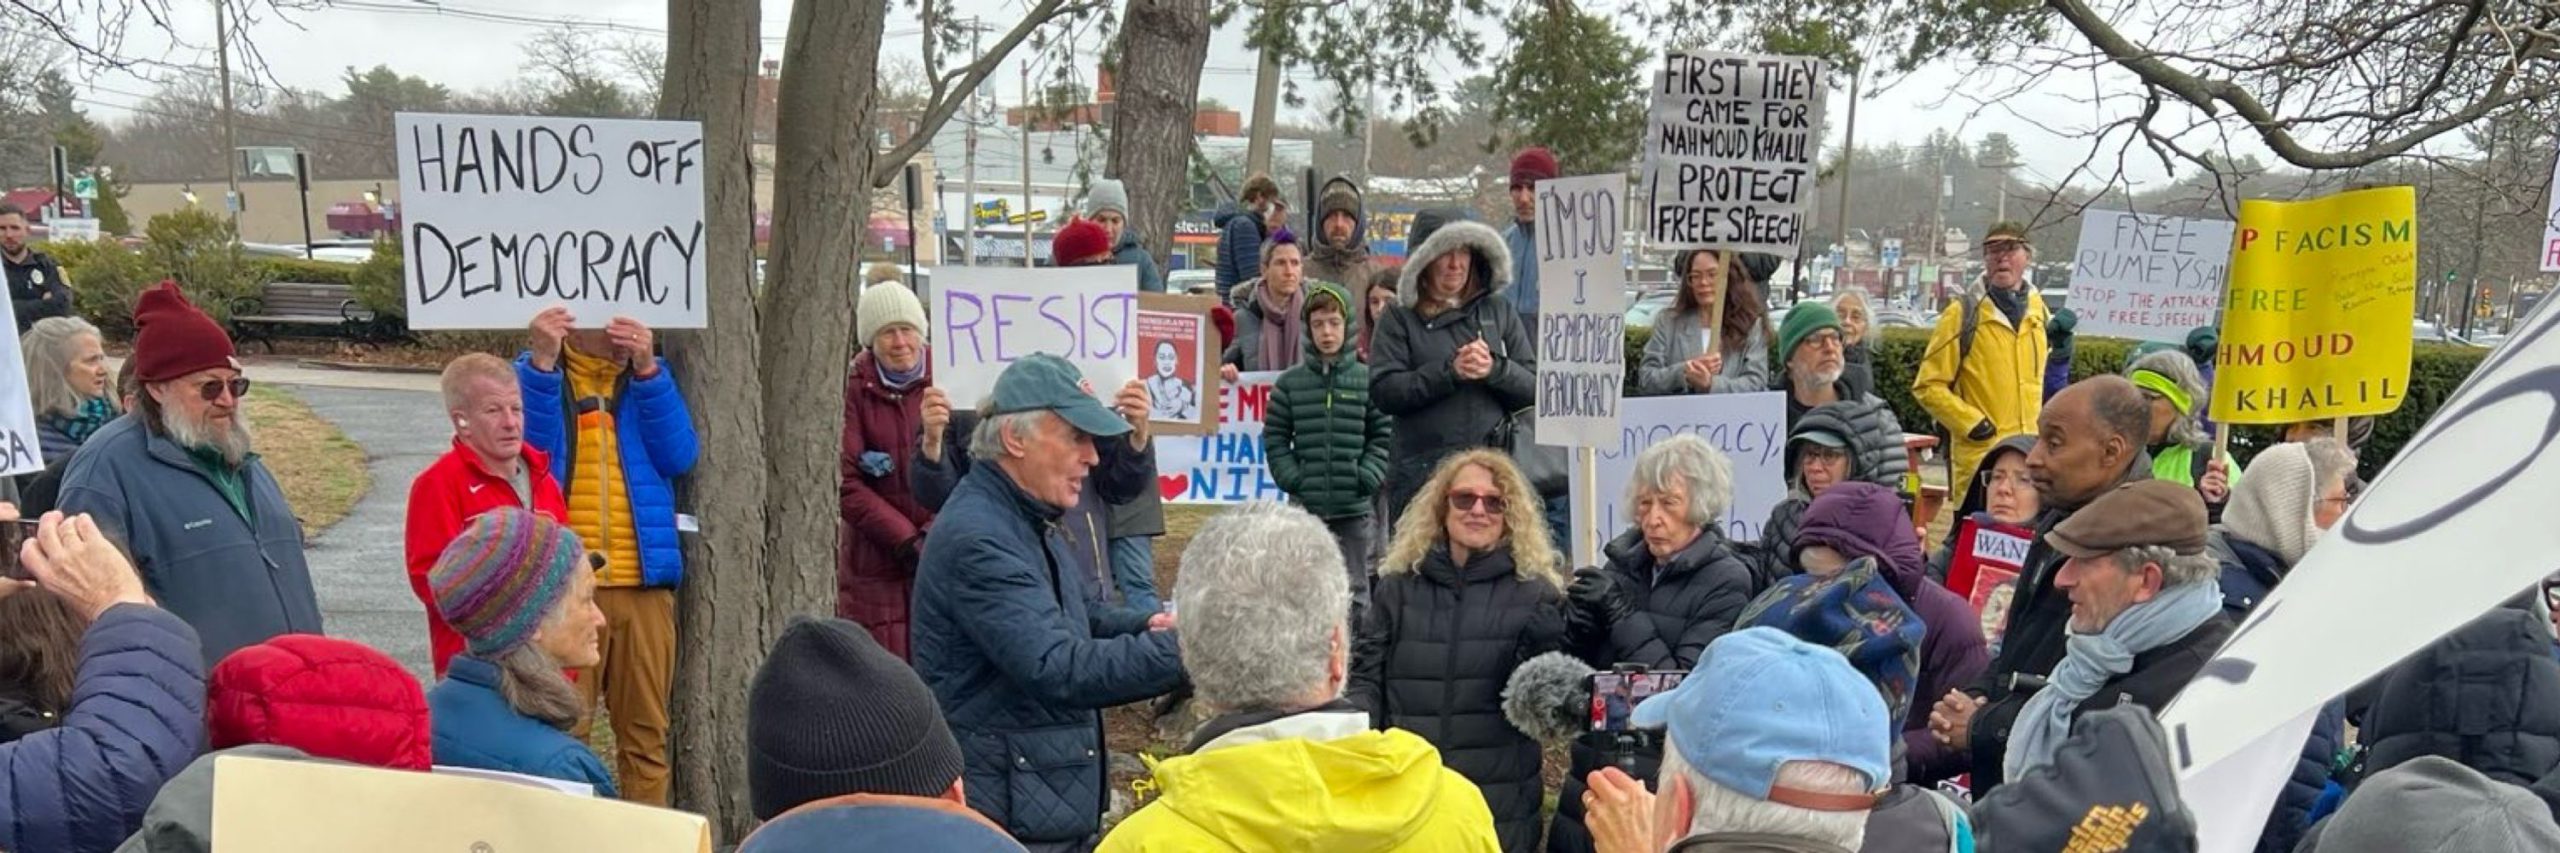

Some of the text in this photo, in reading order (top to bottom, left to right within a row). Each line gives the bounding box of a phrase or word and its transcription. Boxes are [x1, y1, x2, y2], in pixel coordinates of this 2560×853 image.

[1665, 54, 1818, 100] FIRST THEY
[1686, 99, 1809, 128] CAME FOR
[413, 123, 702, 195] HANDS OFF
[1752, 126, 1808, 163] KHALIL
[1679, 163, 1806, 203] PROTECT
[1581, 188, 1616, 256] 90
[1659, 205, 1801, 245] FREE SPEECH
[2115, 214, 2197, 255] FREE
[2275, 220, 2410, 255] FACISM
[412, 220, 703, 311] DEMOCRACY
[1574, 269, 1587, 305] I
[2073, 287, 2117, 303] STOP
[2128, 292, 2155, 309] THE
[2229, 288, 2308, 311] FREE
[946, 290, 1136, 367] RESIST
[2075, 308, 2206, 327] ON FREE SPEECH
[1543, 313, 1624, 365] REMEMBER
[1539, 371, 1620, 418] DEMOCRACY
[2236, 378, 2398, 411] KHALIL
[1978, 533, 2030, 561] WAN
